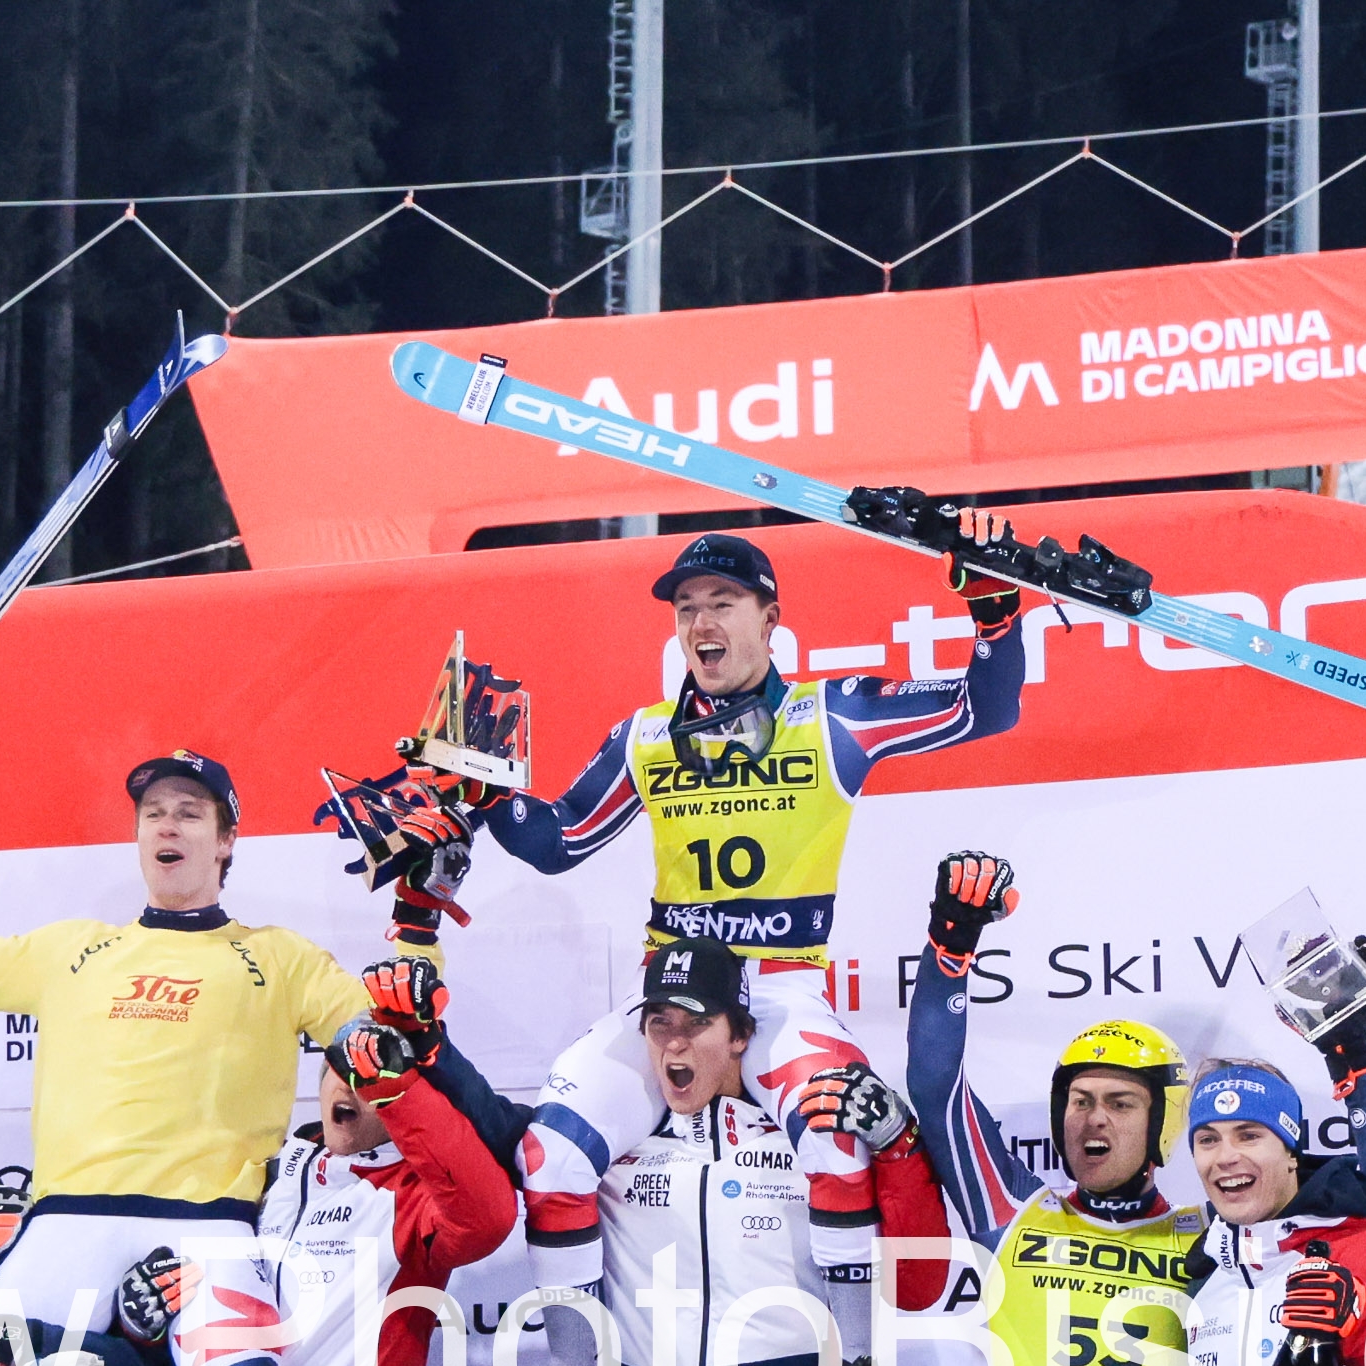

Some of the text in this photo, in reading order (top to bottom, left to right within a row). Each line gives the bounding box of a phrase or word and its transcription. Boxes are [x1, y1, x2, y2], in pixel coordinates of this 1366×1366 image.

[1080, 309, 1331, 364] MADONNA
[1081, 364, 1126, 403] DI
[504, 393, 692, 468] HEAD
[647, 756, 814, 796] ZGONC
[661, 795, 796, 819] www.zgonc.at
[687, 836, 766, 891] 10
[988, 864, 1011, 901] reusch
[665, 904, 792, 943] TRENTINO
[414, 965, 424, 1005] reusch
[898, 943, 1014, 1009] FS
[1046, 937, 1163, 1000] Ski
[108, 1012, 189, 1023] DI CAMPIGLIO
[111, 1006, 189, 1017] MADONNA
[1279, 1114, 1300, 1139] COLMAR
[284, 1147, 306, 1177] COLMAR
[735, 1151, 793, 1171] COLMAR
[634, 1174, 671, 1190] GREEN
[745, 1190, 806, 1202] Rhône-Alpes
[746, 1181, 795, 1193] Auvergne-
[638, 1190, 670, 1208] WEEZ
[1220, 1234, 1233, 1269] COLMAR
[1033, 1275, 1183, 1308] www.zgonc.at
